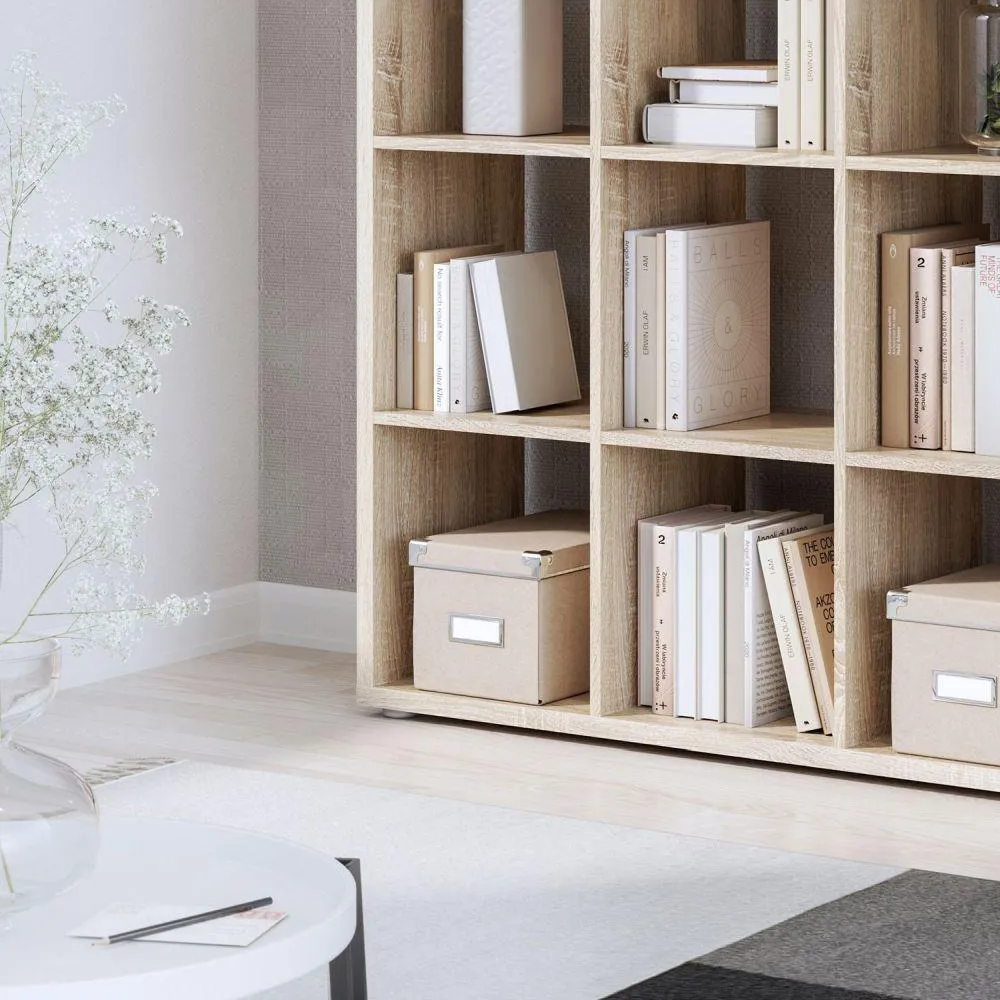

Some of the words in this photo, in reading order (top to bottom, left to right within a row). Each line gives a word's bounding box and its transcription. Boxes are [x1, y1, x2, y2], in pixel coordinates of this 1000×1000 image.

[694, 236, 762, 264] BALLS
[642, 255, 649, 268] AM
[917, 257, 925, 268] 2
[988, 256, 996, 281] MINDS
[979, 255, 987, 286] FUTURE
[988, 283, 996, 295] OF
[725, 316, 734, 335] &
[642, 331, 650, 356] ERWIN
[693, 385, 764, 414] GLORY
[658, 534, 666, 545] 2
[803, 540, 819, 553] THE
[806, 555, 817, 567] TO
